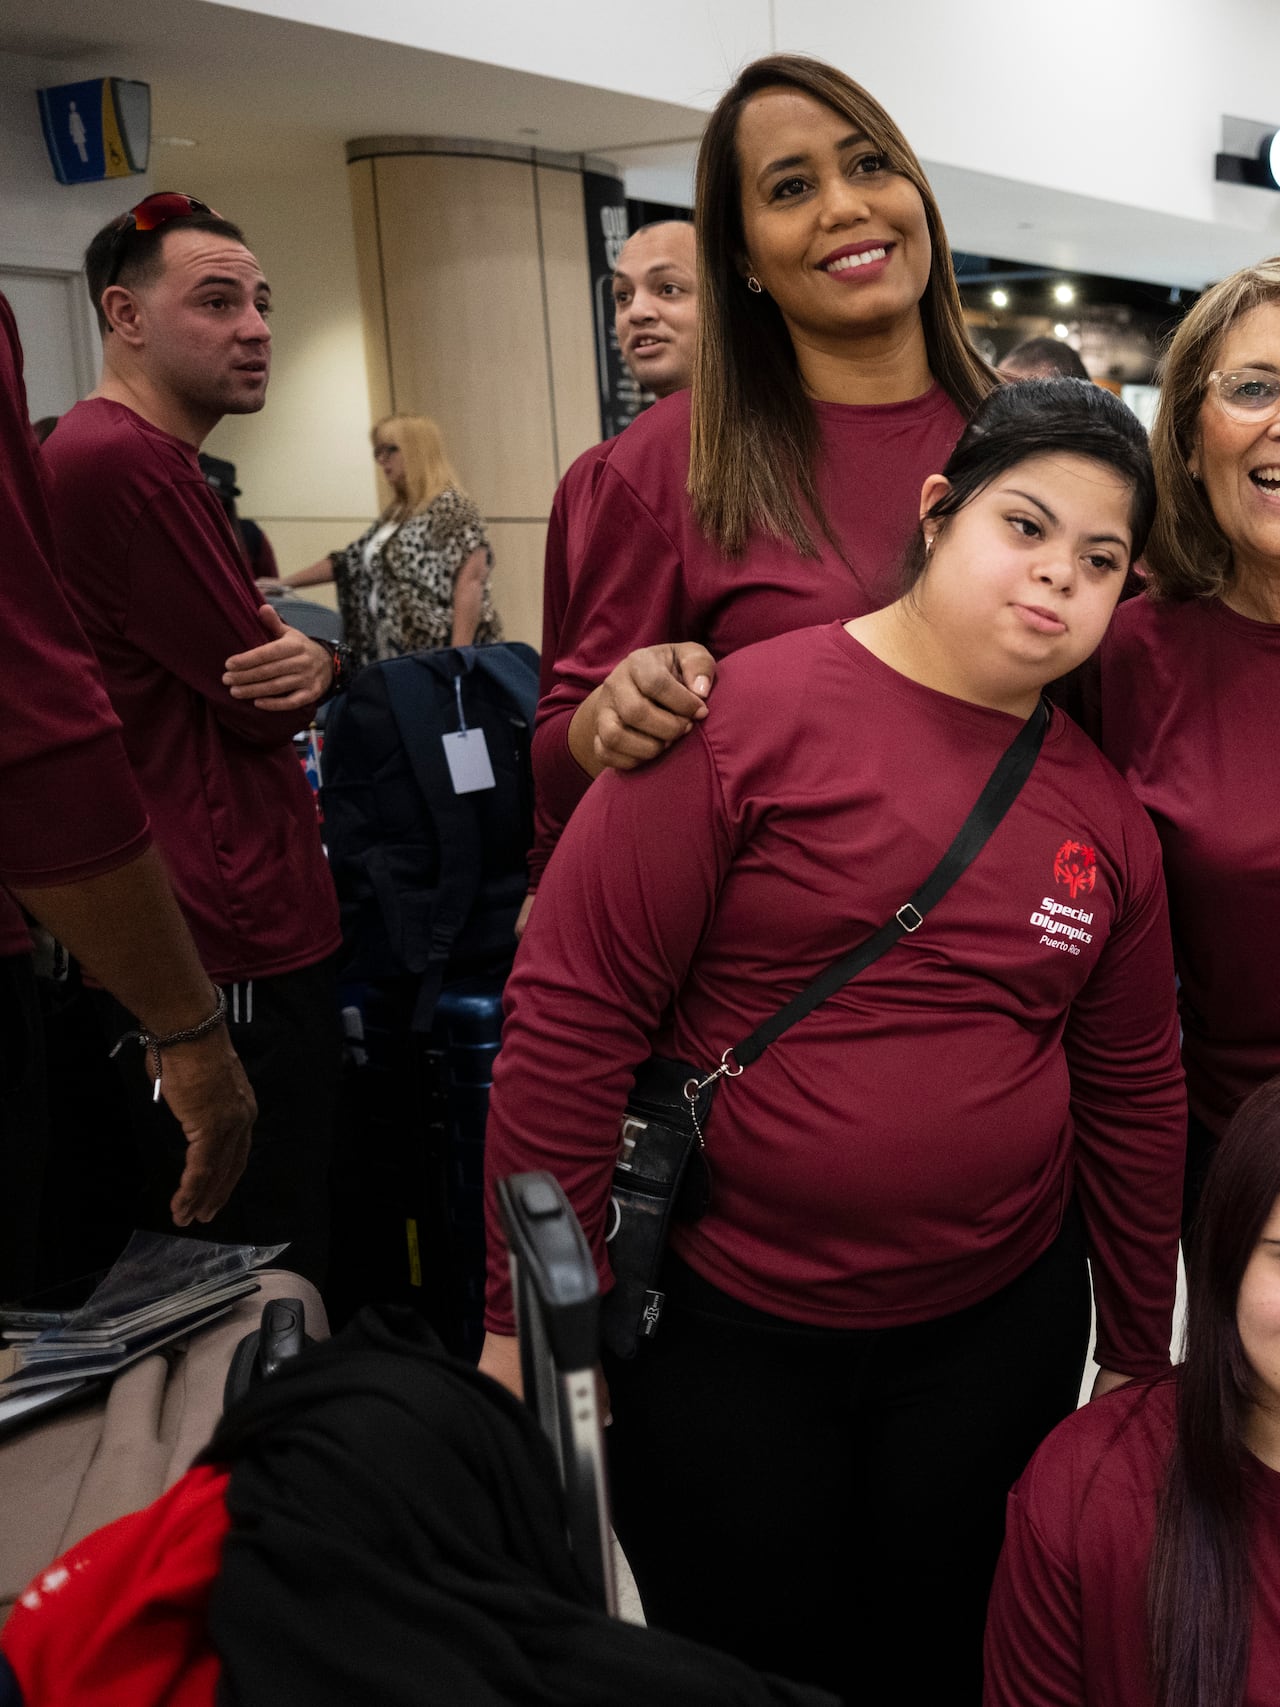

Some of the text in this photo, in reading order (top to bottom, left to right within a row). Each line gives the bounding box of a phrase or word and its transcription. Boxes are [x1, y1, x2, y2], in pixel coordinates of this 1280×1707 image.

[1040, 896, 1094, 925] Special
[1029, 911, 1094, 944] Olympics
[1039, 934, 1081, 956] Puerto Rico
